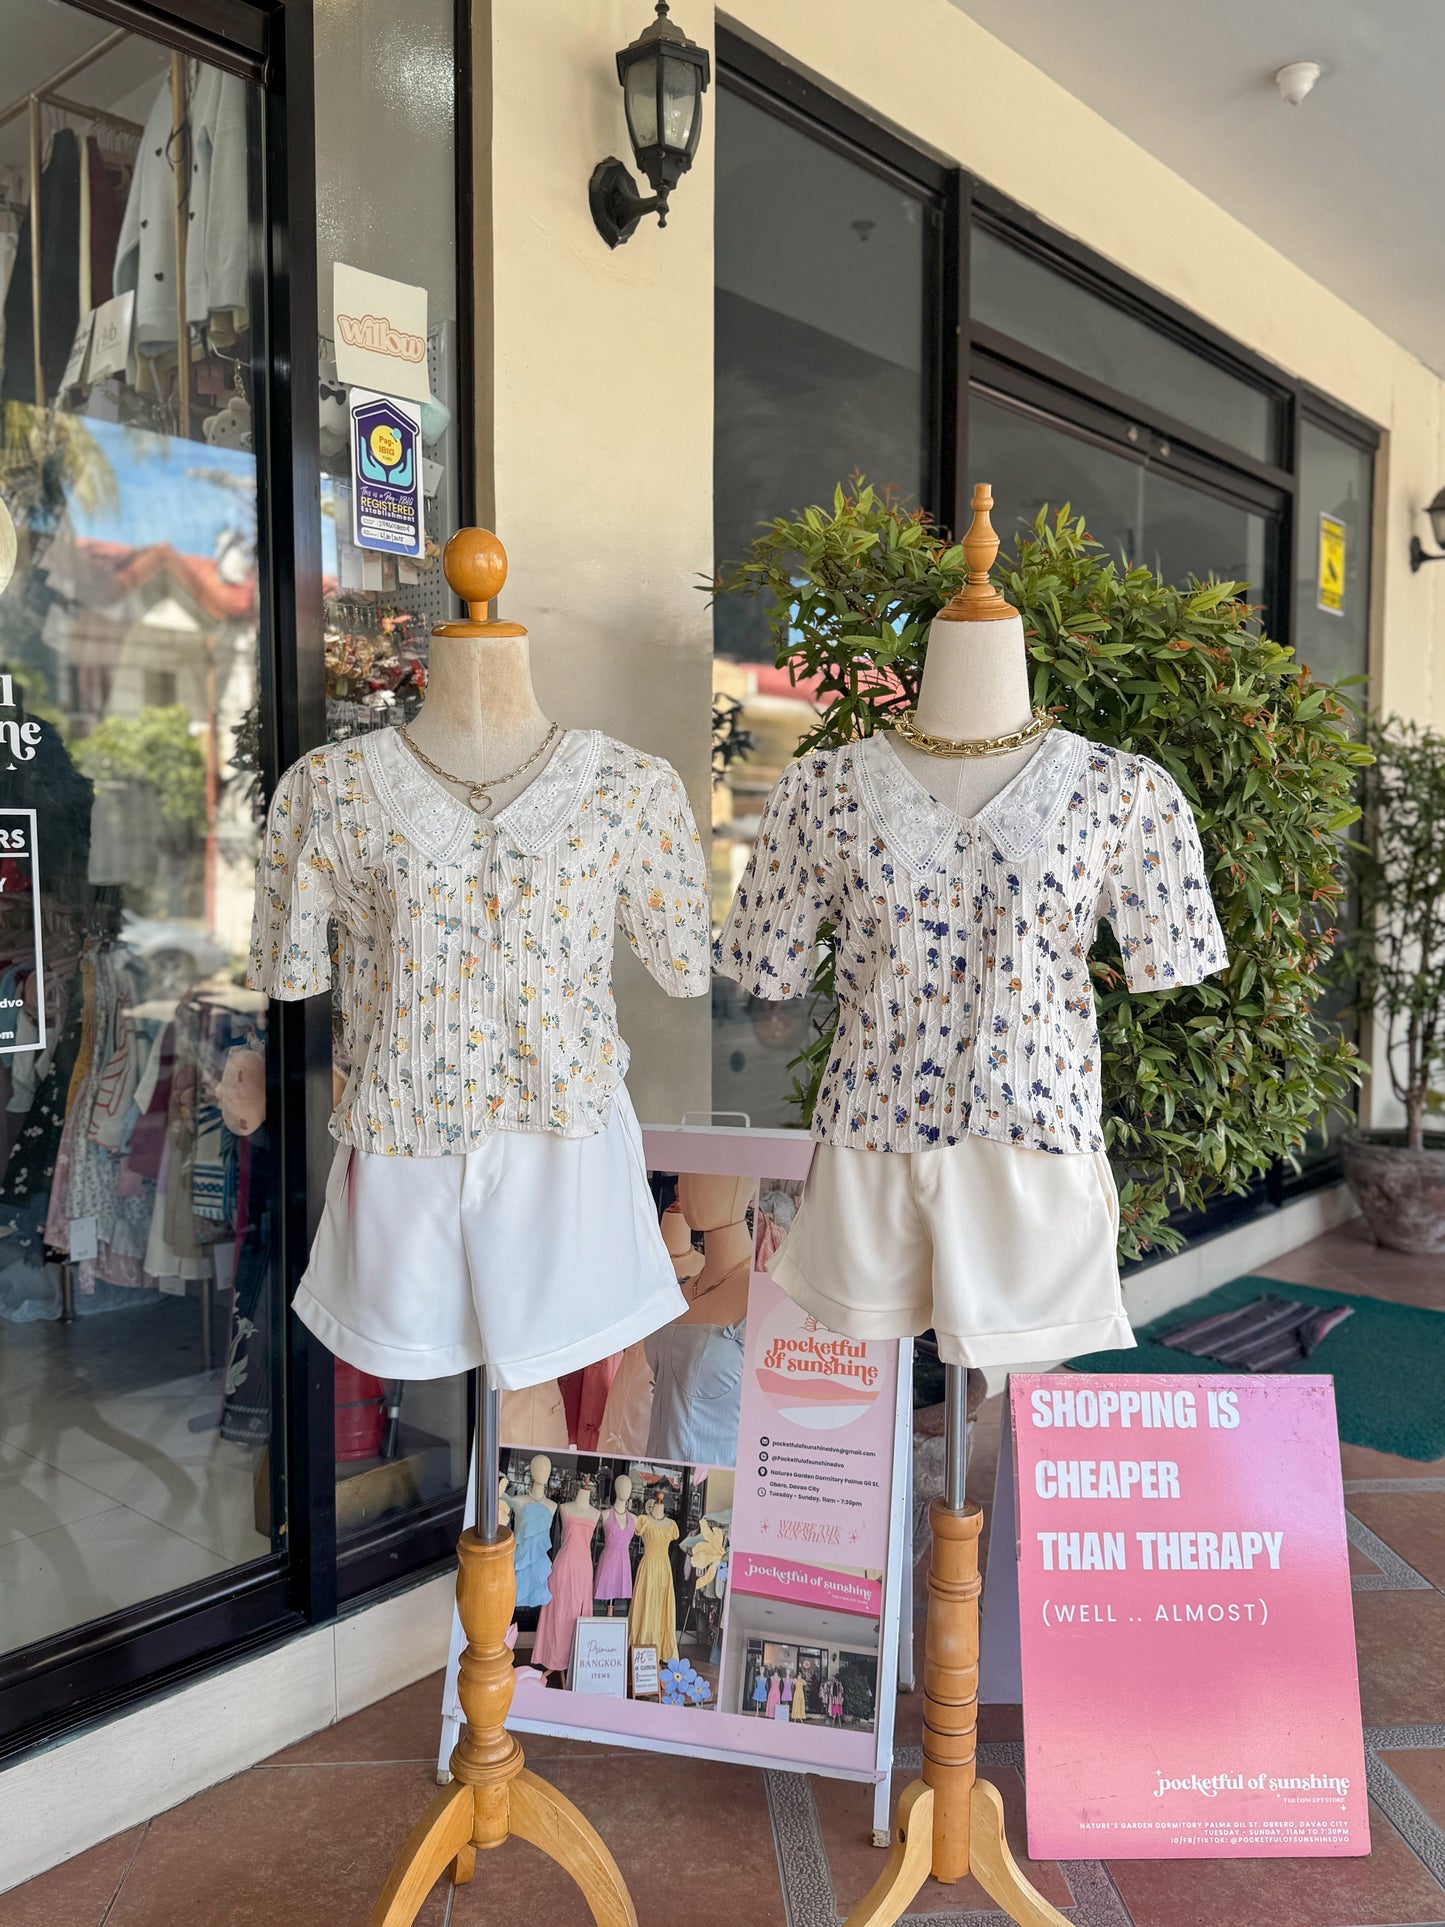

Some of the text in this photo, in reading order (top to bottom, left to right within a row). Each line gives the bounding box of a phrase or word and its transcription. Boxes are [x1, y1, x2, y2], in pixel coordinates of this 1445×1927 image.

[379, 436, 395, 447] Pag-
[379, 446, 395, 456] IBIG
[361, 497, 415, 517] REGISTERED
[361, 506, 415, 523] Establishment
[766, 1337, 867, 1363] pocketful
[763, 1349, 879, 1386] of sunshine
[1031, 1389, 1240, 1428] SHOPPING IS
[772, 1440, 876, 1458] pocketfulofsunshinedvo@gmail.com
[771, 1455, 845, 1469] @Pocketfulofsunshinedvo
[793, 1471, 815, 1479] Garden
[815, 1474, 844, 1484] Dormitory
[1035, 1460, 1181, 1499] CHEAPER
[769, 1490, 794, 1500] Tuesday
[788, 1483, 808, 1491] Davao
[808, 1485, 820, 1493] City
[1037, 1531, 1283, 1570] THAN THERAPY
[744, 1563, 872, 1601] pocketful of sunshine
[1042, 1600, 1117, 1627] (WELL
[1155, 1599, 1268, 1626] ALMOST)
[580, 1659, 622, 1668] BANGKOK
[1153, 1773, 1350, 1798] pocketful of sunshine
[1263, 1821, 1297, 1829] OBRERO,
[1170, 1836, 1350, 1845] IG/FB/TIKTOK: @POCKETFULOFSUNSHINEDVO
